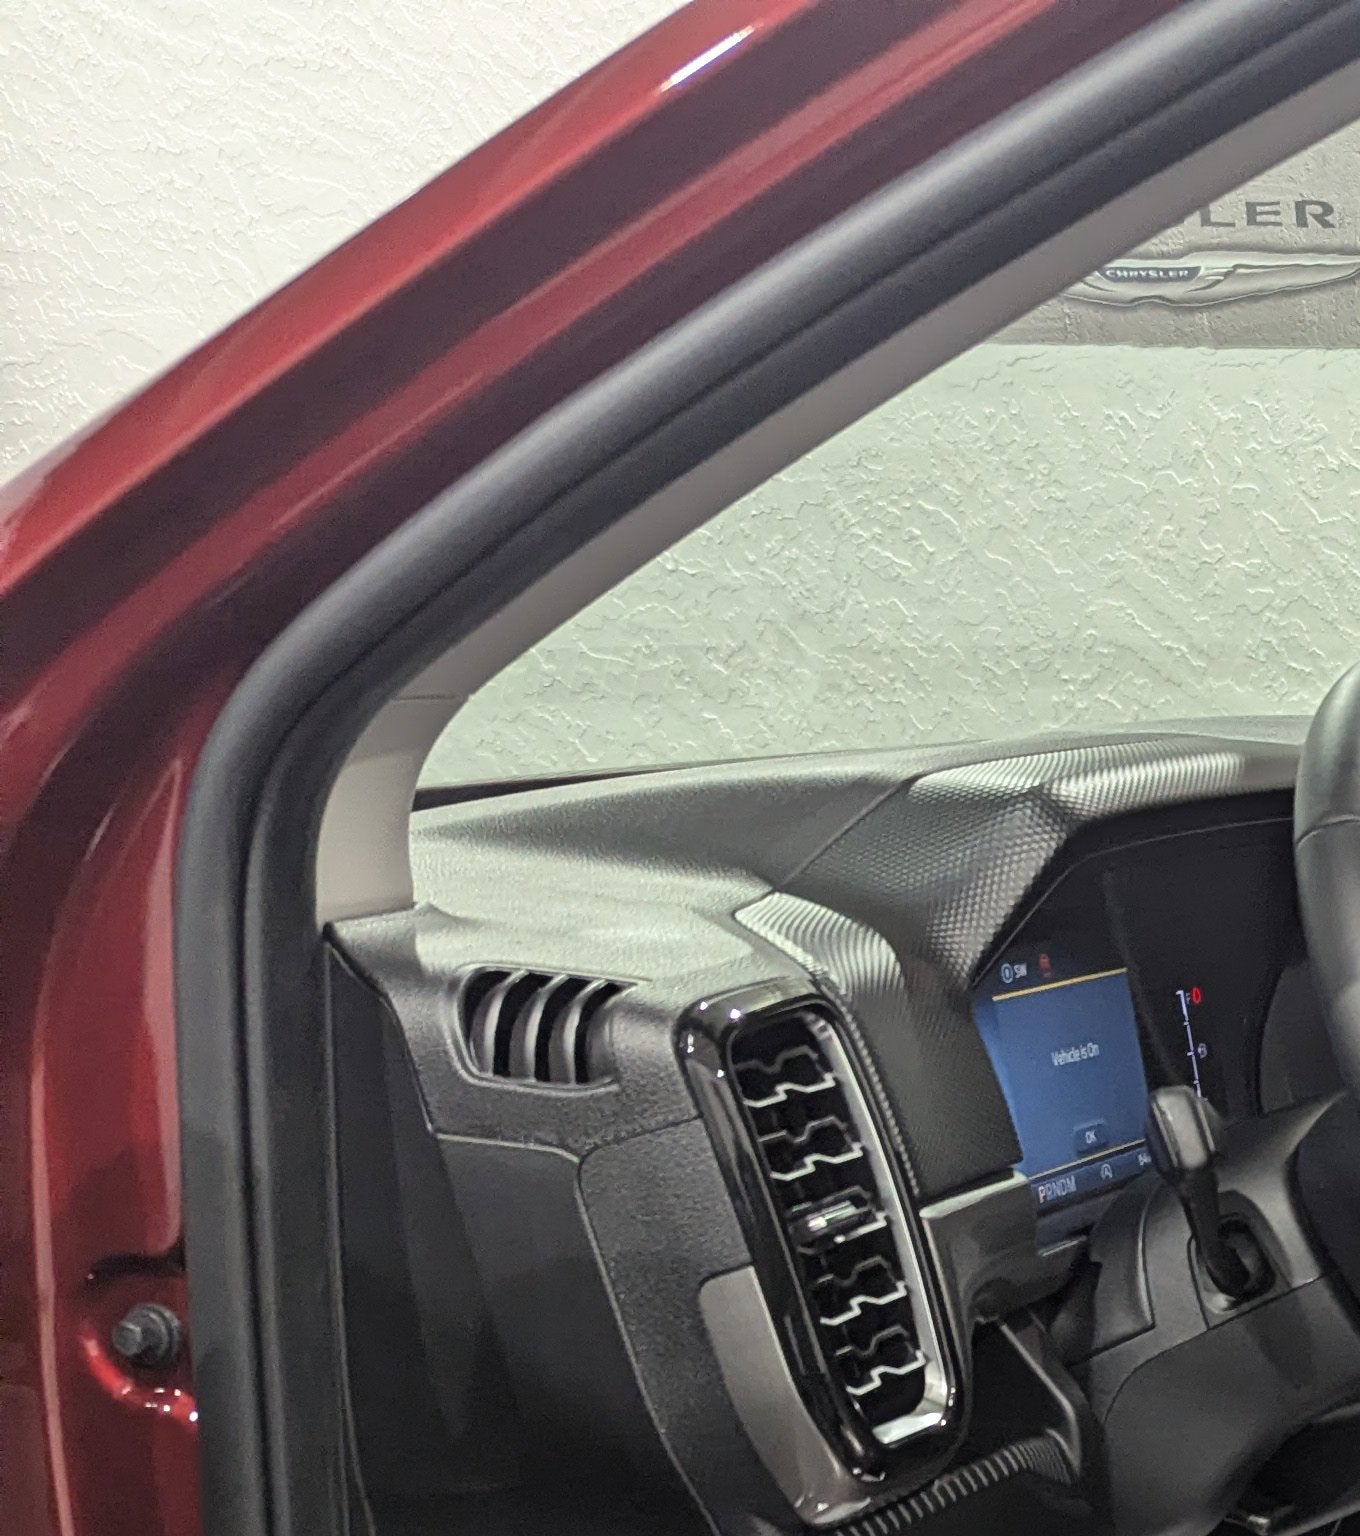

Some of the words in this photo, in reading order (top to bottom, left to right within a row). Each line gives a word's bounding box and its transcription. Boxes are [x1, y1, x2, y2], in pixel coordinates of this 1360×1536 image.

[1200, 199, 1336, 229] LER
[1105, 267, 1190, 280] CHRYSLER
[1051, 1046, 1081, 1066] Vehicle
[1087, 1042, 1100, 1058] On
[1085, 1130, 1097, 1144] OK
